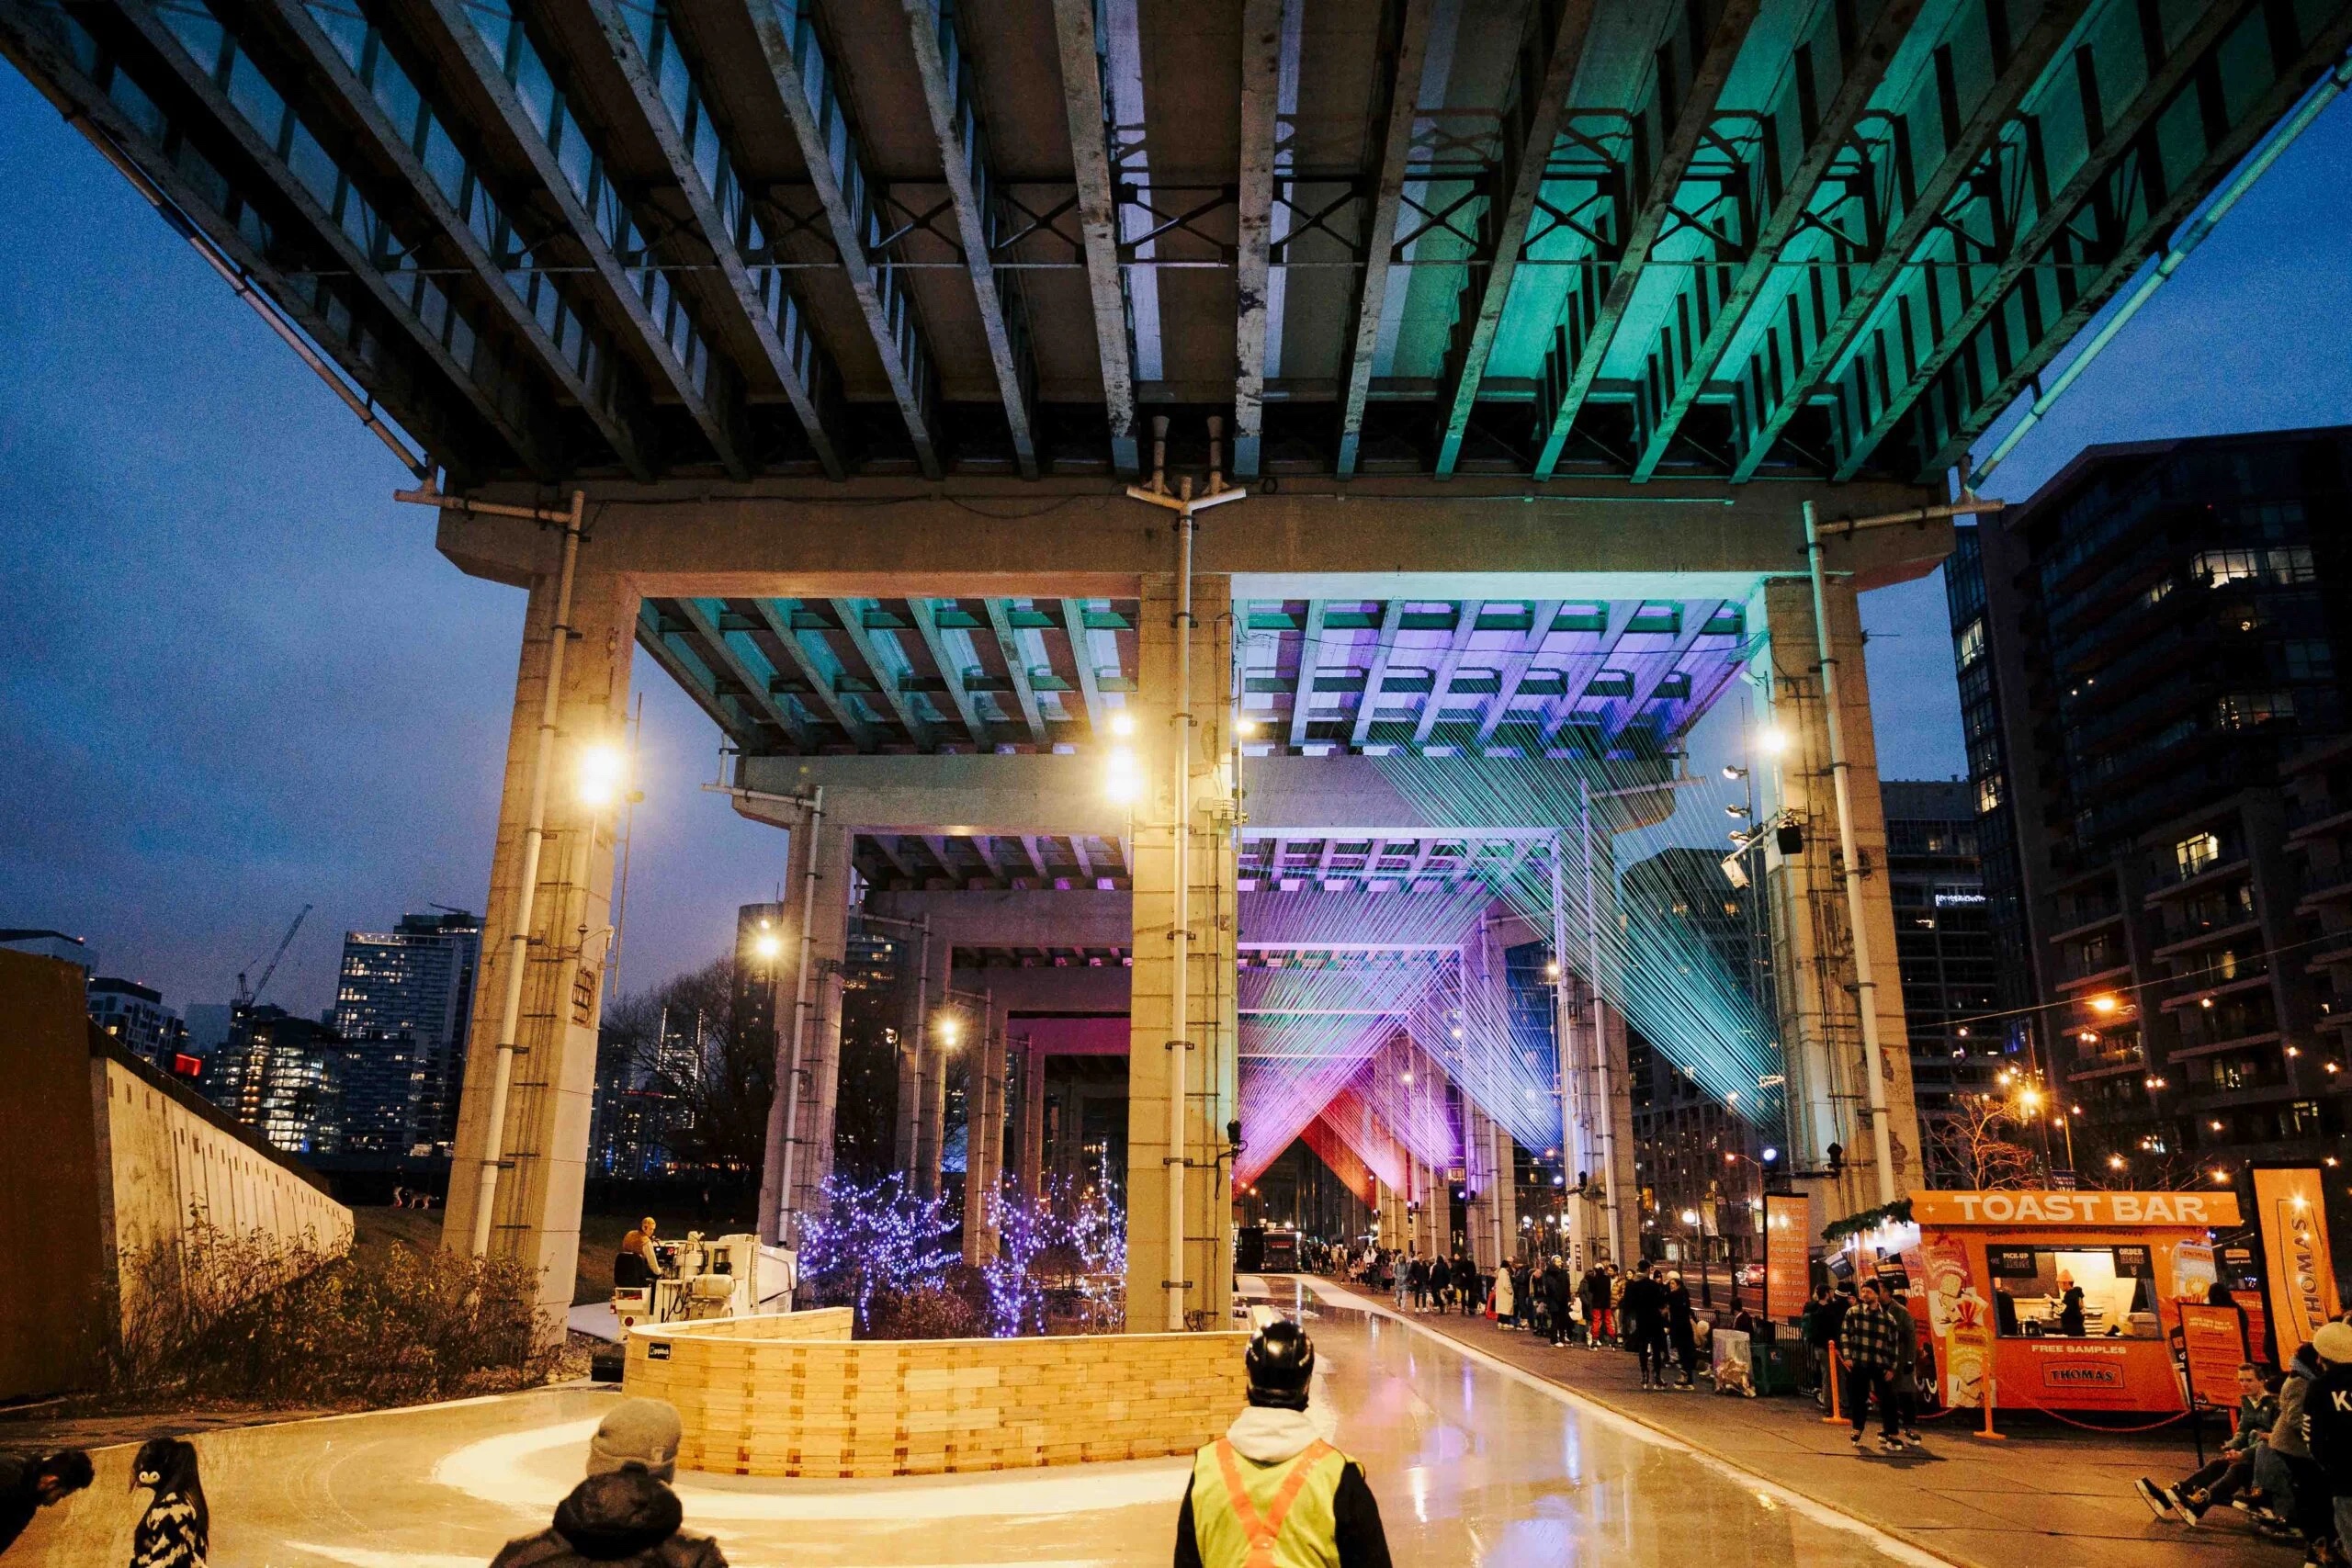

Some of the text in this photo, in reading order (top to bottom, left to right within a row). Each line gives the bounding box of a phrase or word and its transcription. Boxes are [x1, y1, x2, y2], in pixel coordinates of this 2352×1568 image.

[1954, 1195, 2208, 1223] TOAST BAR
[2291, 1218, 2324, 1333] THOMAS
[2031, 1344, 2127, 1354] FREE SAMPLES
[2050, 1369, 2115, 1382] THOMAS
